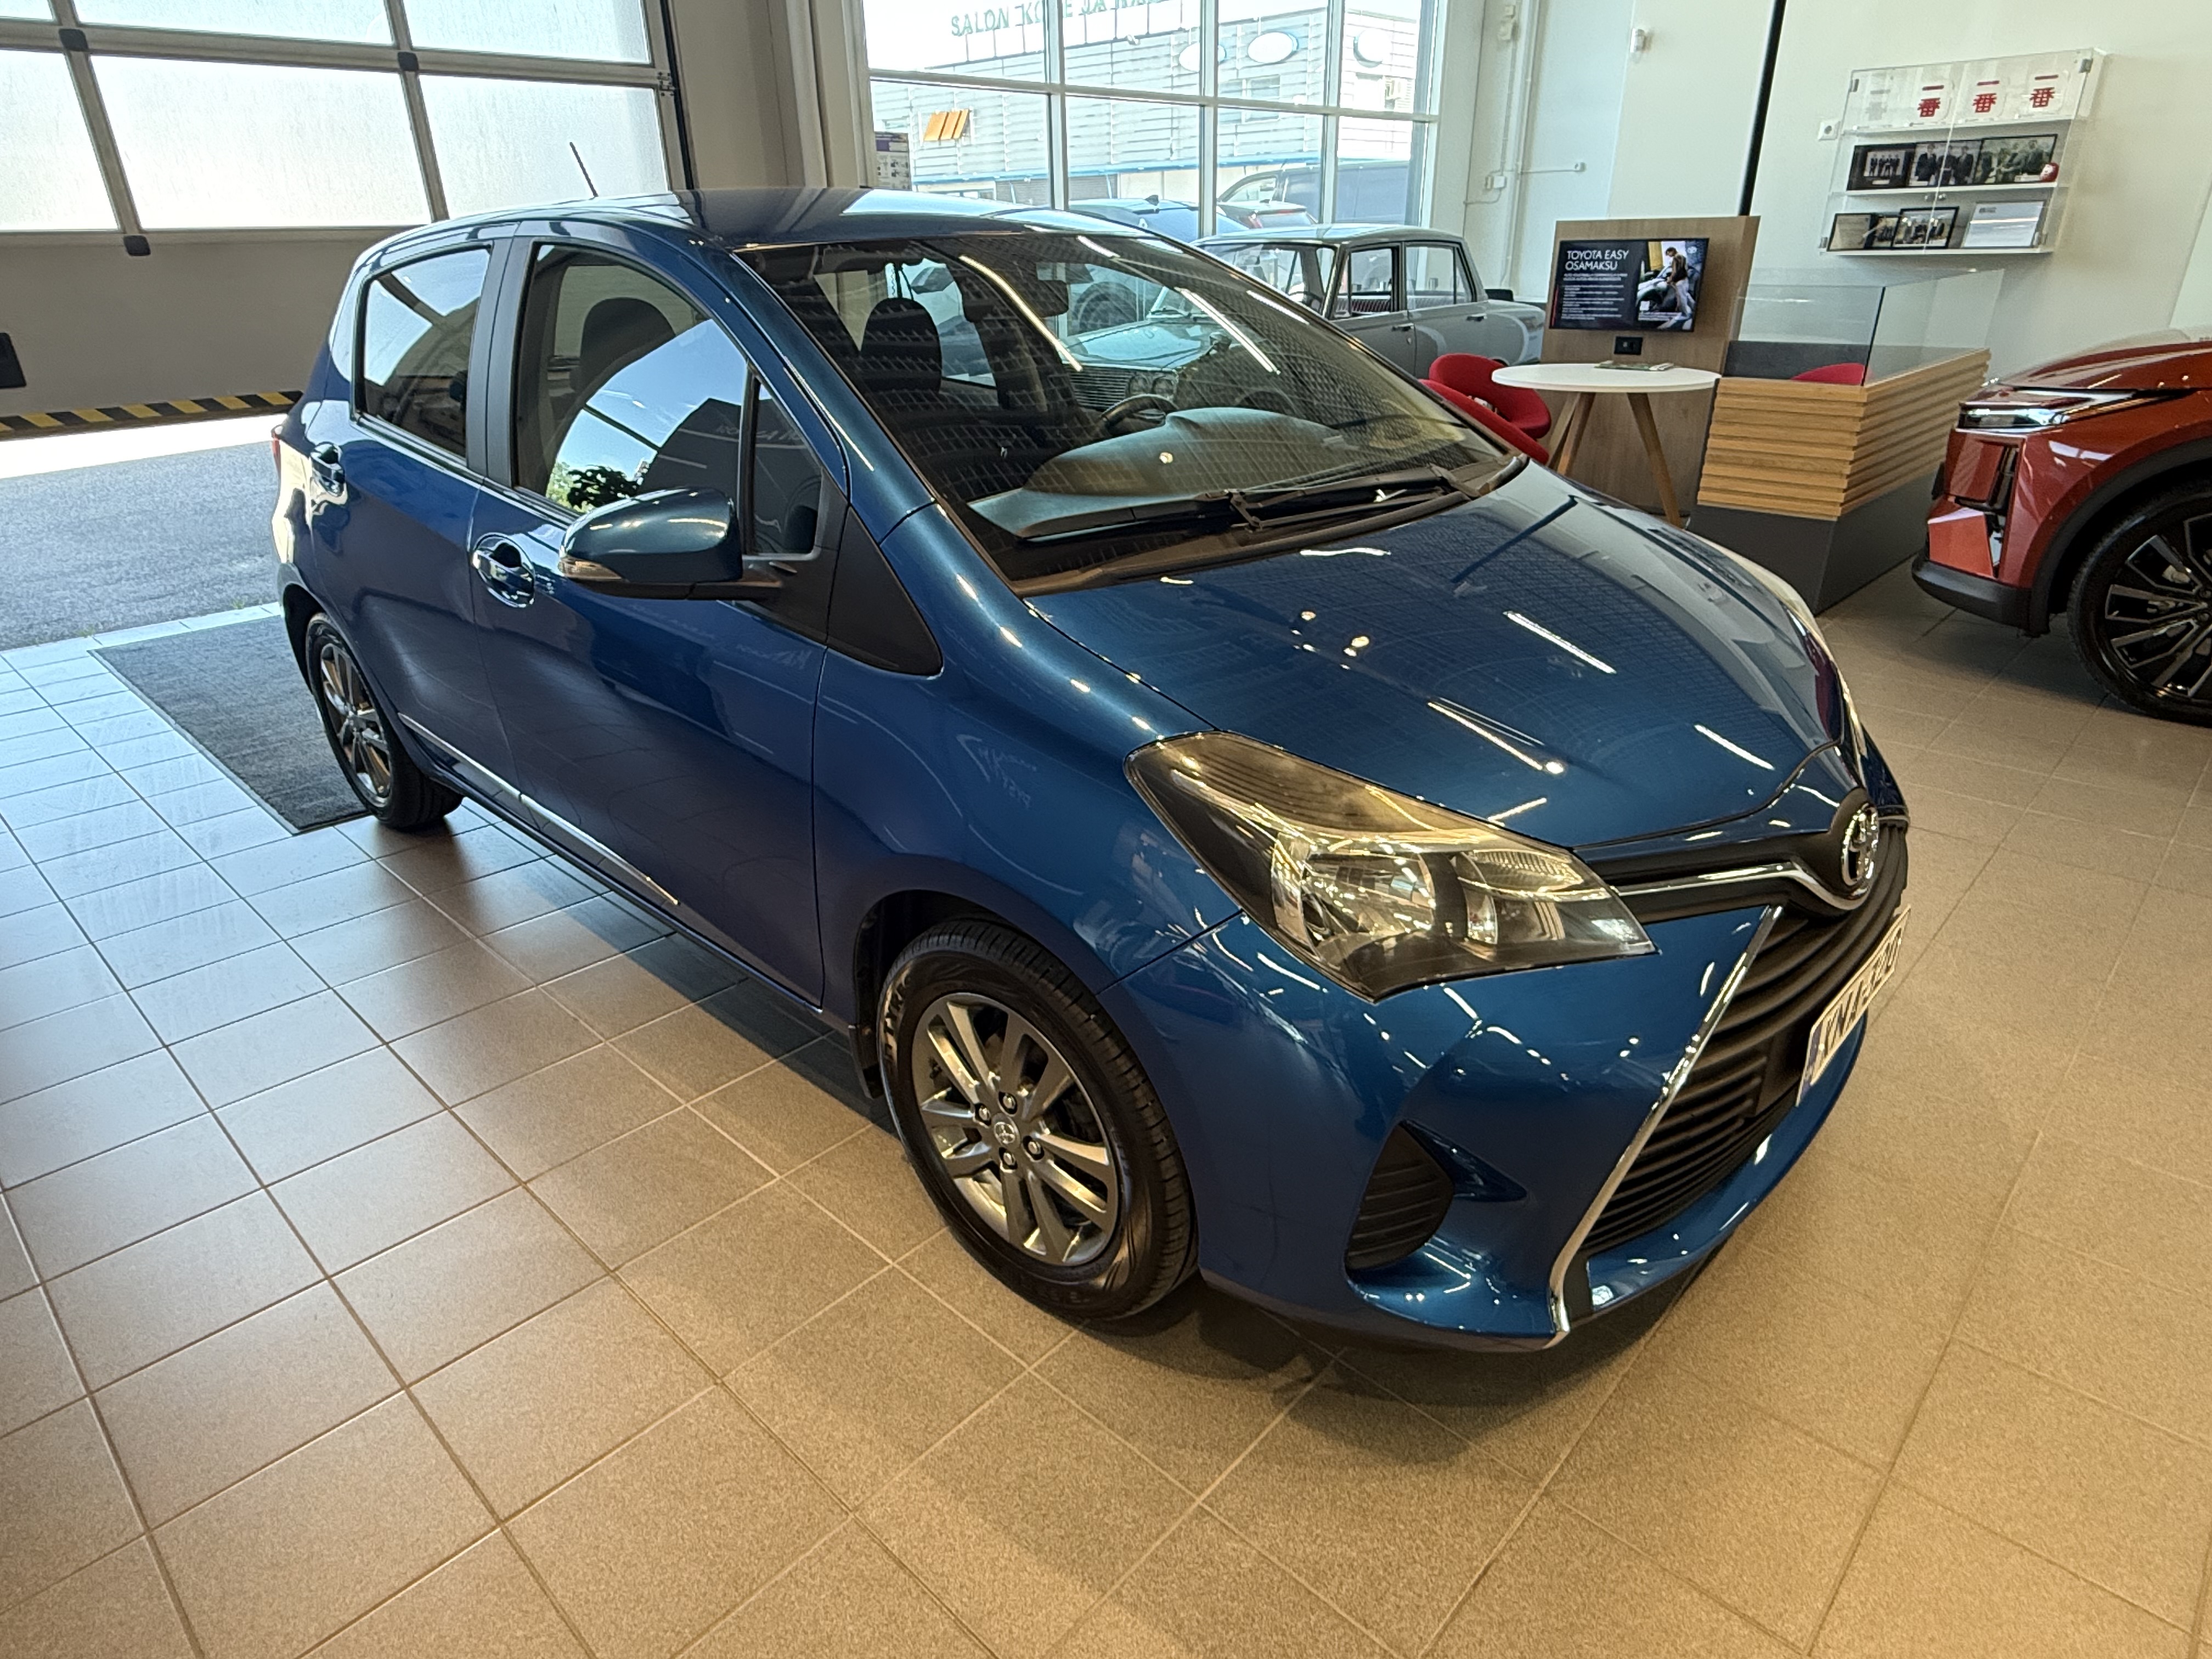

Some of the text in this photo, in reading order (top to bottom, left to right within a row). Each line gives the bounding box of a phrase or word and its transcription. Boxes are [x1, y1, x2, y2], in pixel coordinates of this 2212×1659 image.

[951, 5, 1009, 37] SALON
[1022, 0, 1073, 25] KOE
[1567, 249, 1629, 260] TOYOTA EASY
[1565, 260, 1618, 271] OSAMAKSU
